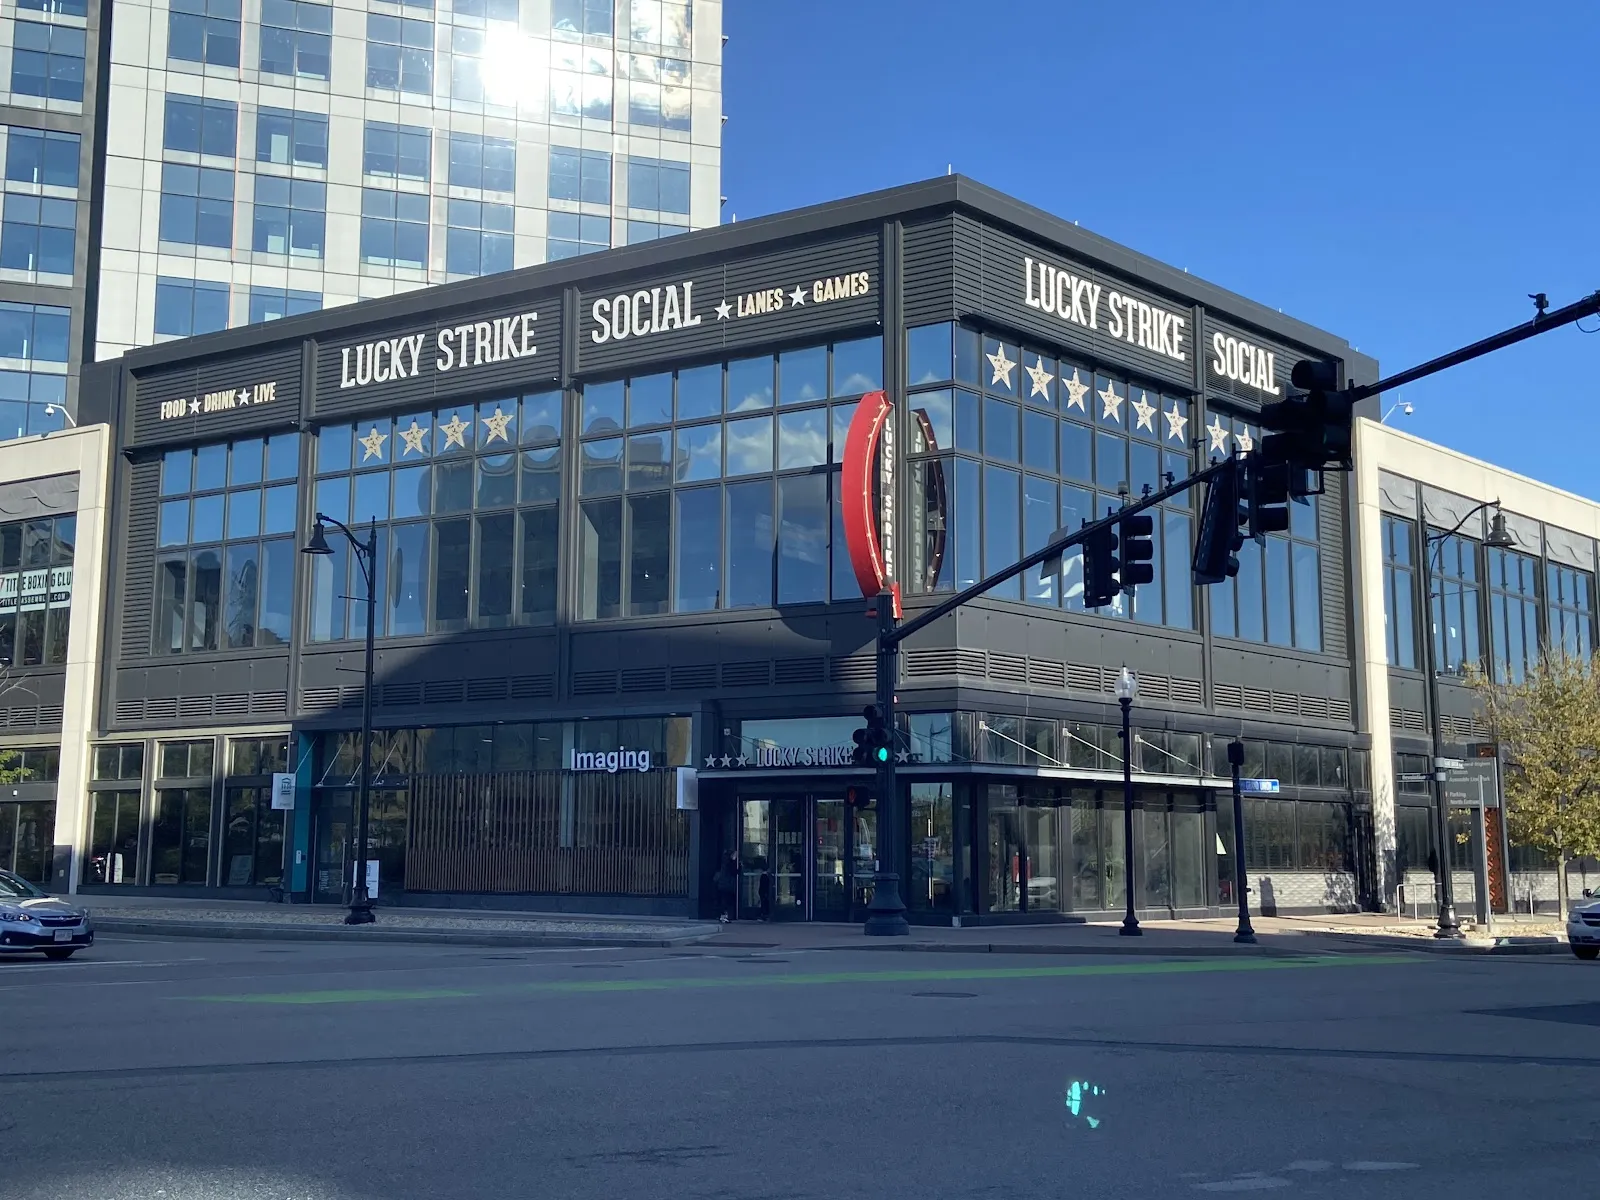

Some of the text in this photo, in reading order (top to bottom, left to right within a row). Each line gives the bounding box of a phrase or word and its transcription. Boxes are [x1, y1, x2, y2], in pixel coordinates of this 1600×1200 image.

[591, 281, 701, 344] SOCIAL
[737, 271, 869, 318] LANES GAMES
[1024, 257, 1186, 361] LUCKY STRIKE
[340, 312, 538, 388] LUCKY STRIKE
[1213, 332, 1280, 395] SOCIAL
[160, 382, 277, 420] FOOD DRINK LIVE
[885, 418, 893, 577] LUCKY STRIKE
[6, 577, 27, 592] TITE
[57, 571, 72, 586] CLU
[571, 745, 650, 773] Imaging
[756, 745, 855, 767] LUCKY STRIKE
